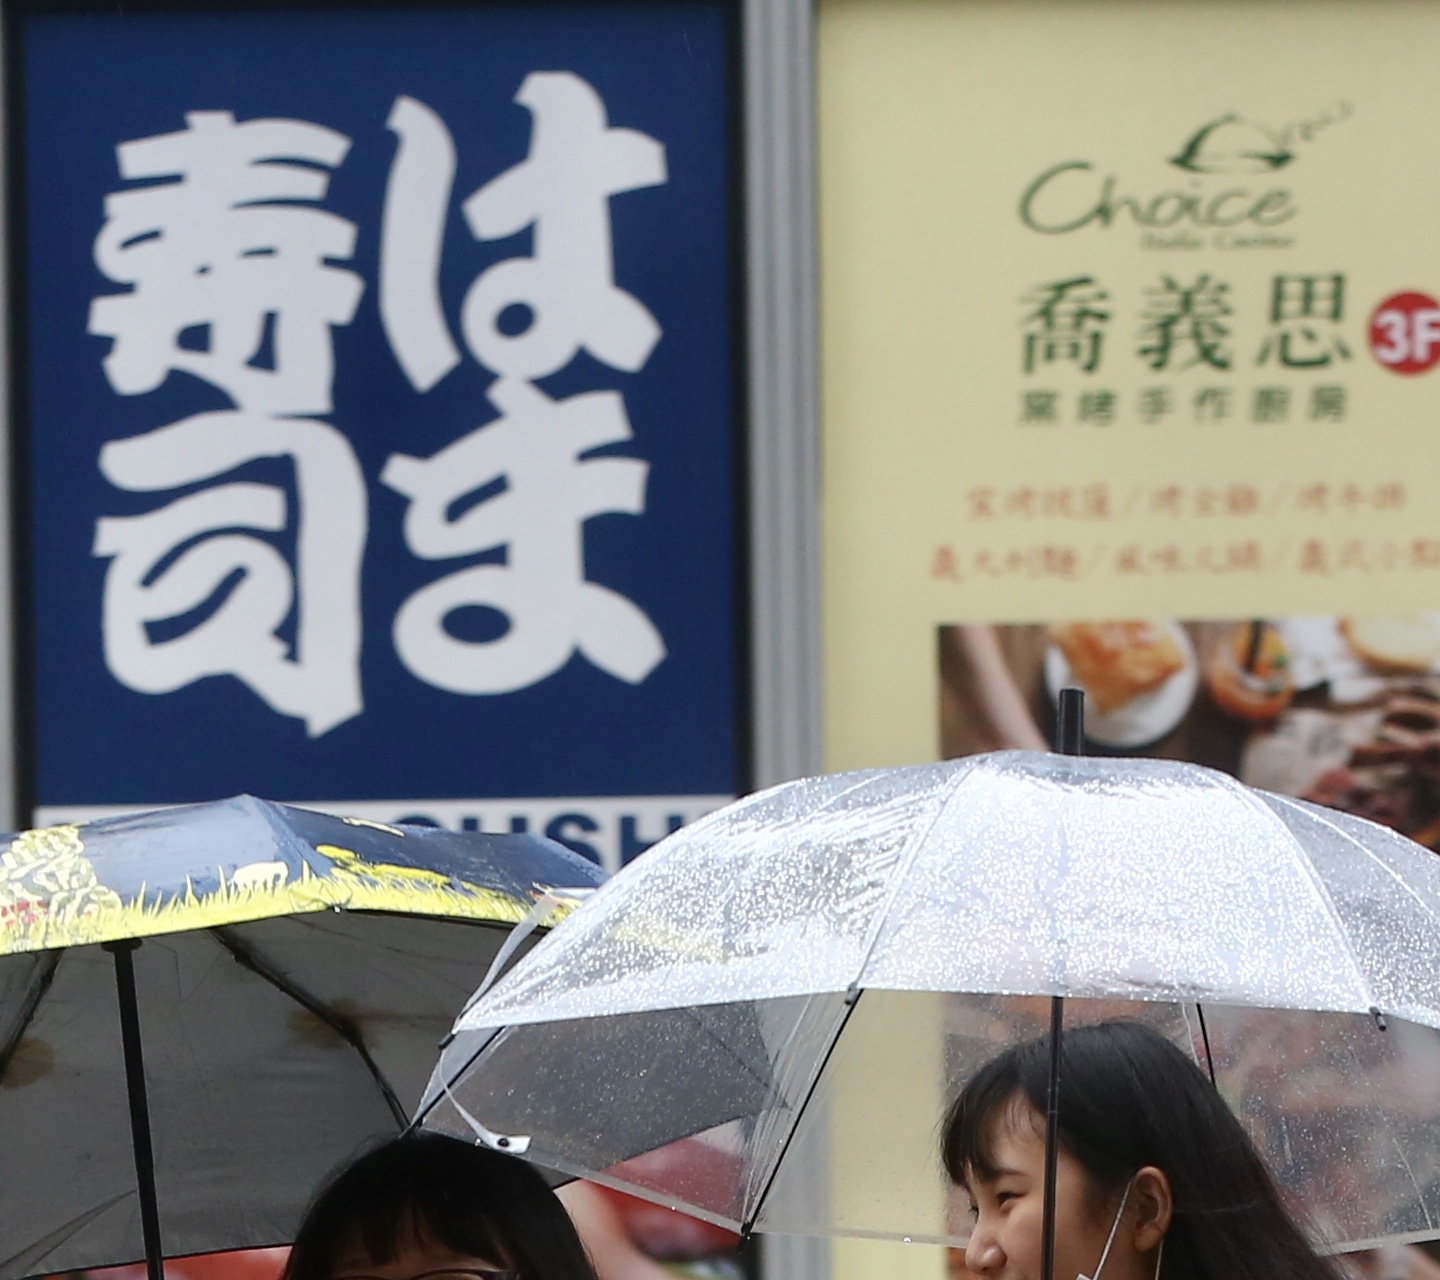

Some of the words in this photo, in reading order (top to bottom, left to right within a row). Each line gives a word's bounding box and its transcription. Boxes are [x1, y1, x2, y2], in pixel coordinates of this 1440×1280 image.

[1019, 160, 1298, 236] Choice
[1023, 272, 1354, 374] 喬義思
[87, 110, 368, 737] 寿司
[379, 70, 667, 695] はま
